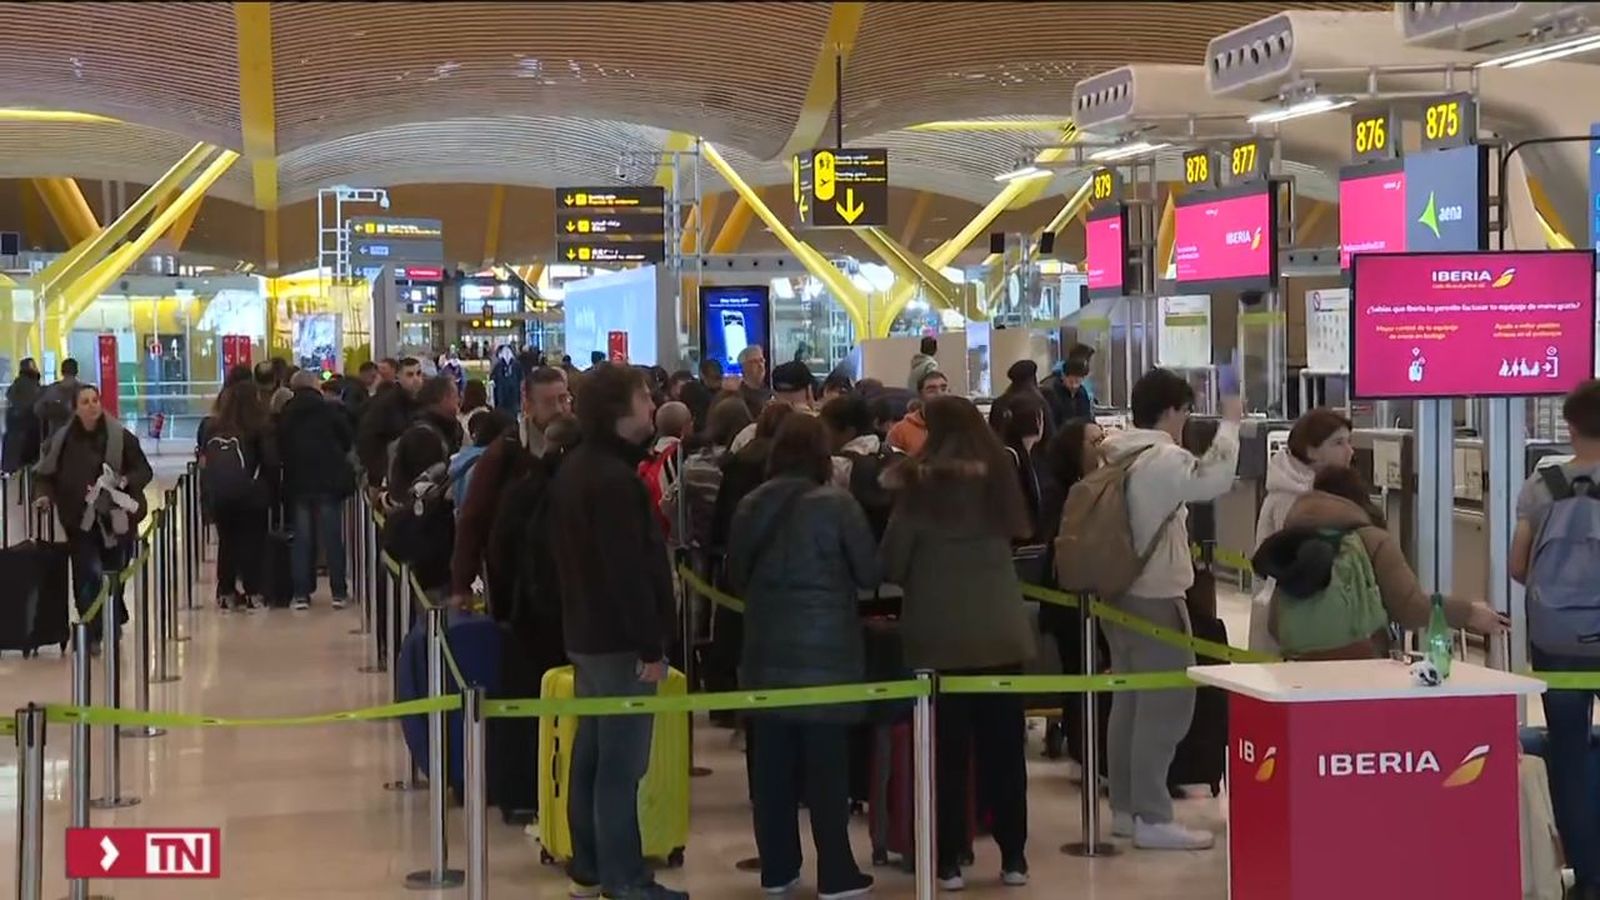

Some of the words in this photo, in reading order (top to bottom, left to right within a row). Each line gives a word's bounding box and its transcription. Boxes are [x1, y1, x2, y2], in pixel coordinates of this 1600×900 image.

[1426, 103, 1459, 139] 875
[1355, 118, 1385, 153] 876
[1186, 154, 1208, 183] 878
[1231, 144, 1256, 175] 877
[1094, 174, 1112, 199] 879
[1438, 206, 1462, 221] aena
[1225, 230, 1251, 244] IBERIA
[1432, 270, 1492, 281] IBERIA
[1239, 738, 1255, 763] IB
[1318, 750, 1441, 777] IBERIA
